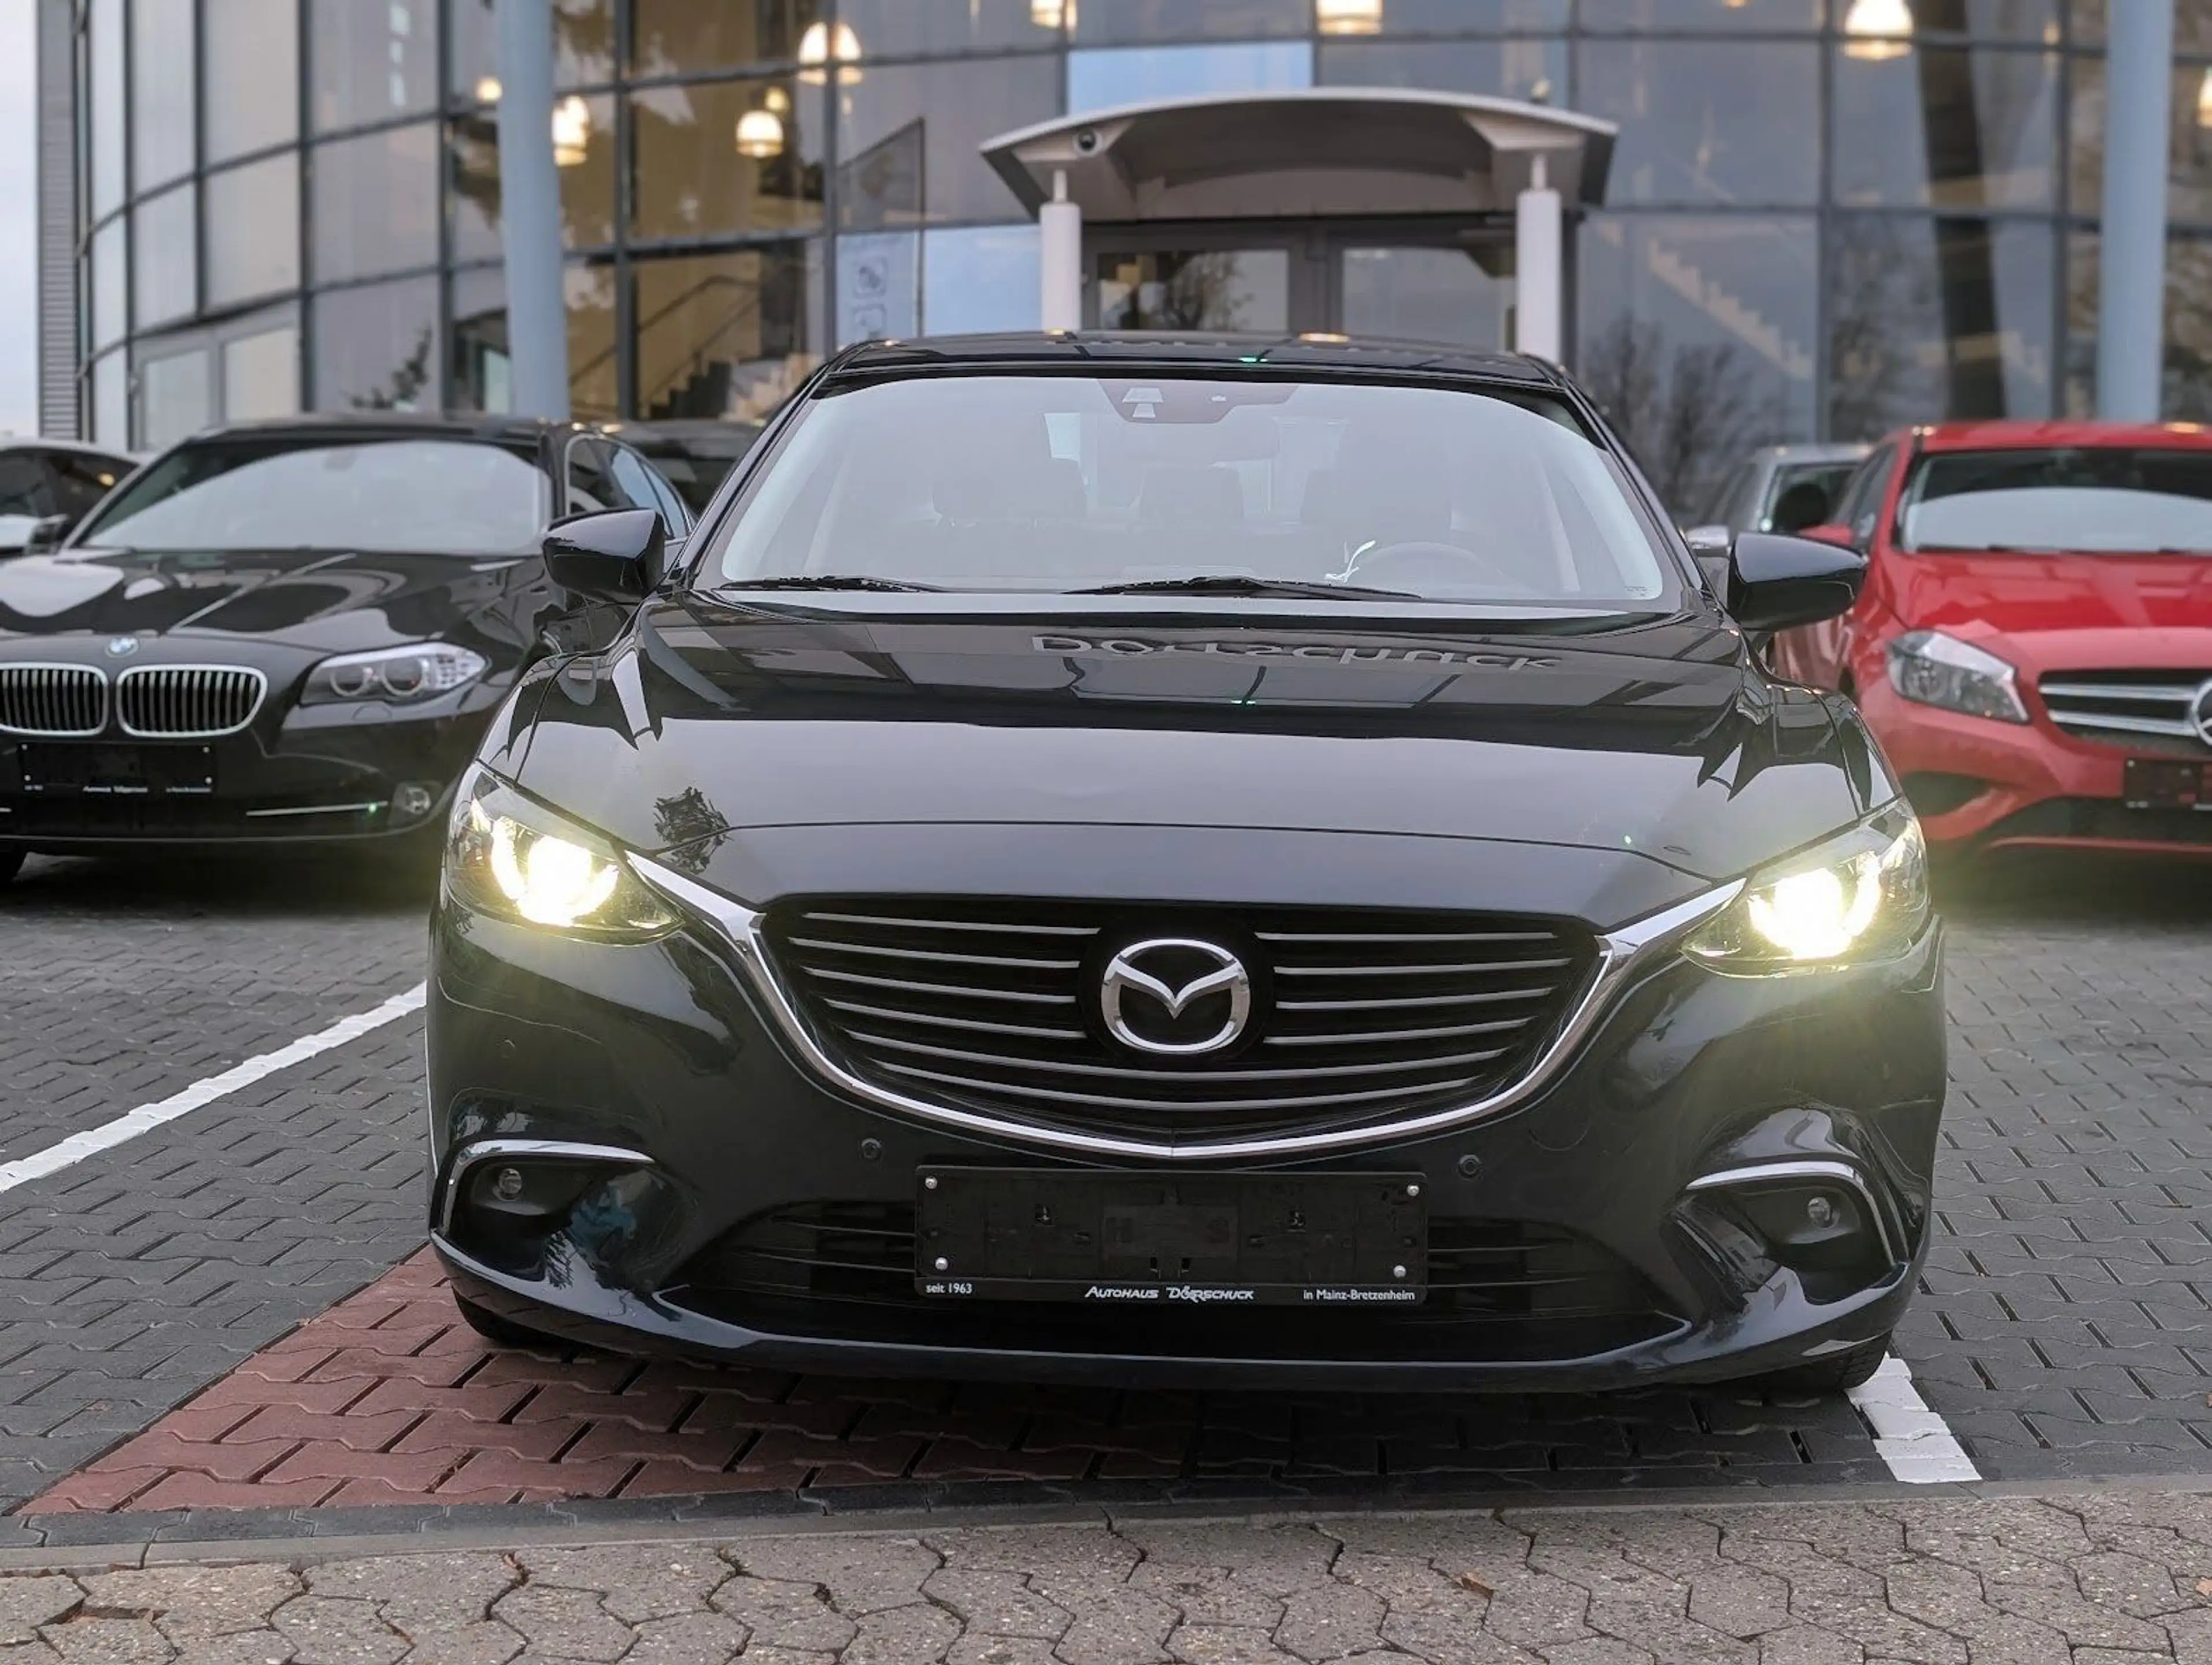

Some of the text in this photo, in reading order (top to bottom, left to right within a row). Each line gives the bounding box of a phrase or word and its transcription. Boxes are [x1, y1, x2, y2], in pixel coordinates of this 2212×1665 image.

[926, 1282, 973, 1294] seit 1963
[1085, 1286, 1159, 1299] AUTOHAUS
[1303, 1289, 1415, 1300] in Mainz-Bretzenheim
